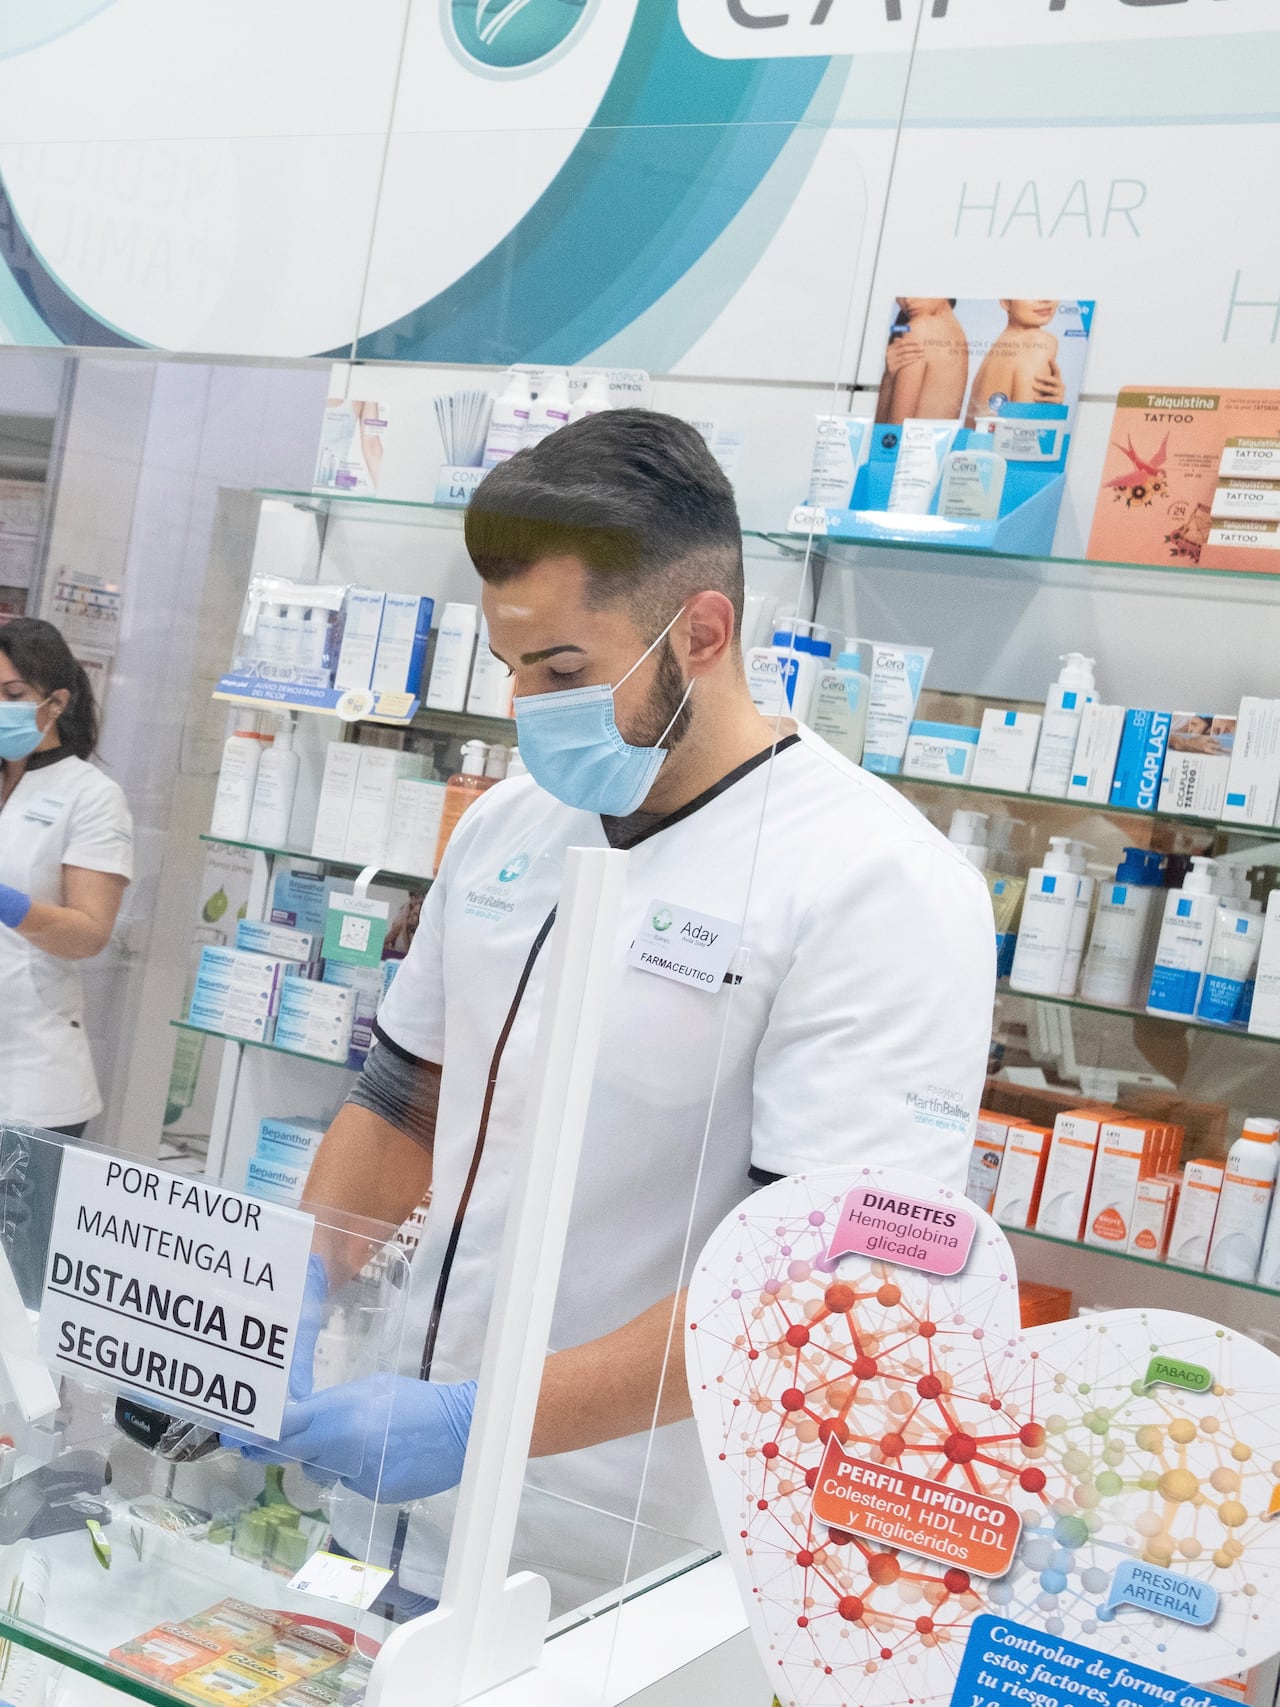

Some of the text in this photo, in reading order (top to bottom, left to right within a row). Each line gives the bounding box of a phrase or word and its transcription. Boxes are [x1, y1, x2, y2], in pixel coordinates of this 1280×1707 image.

[952, 177, 1147, 240] HAAR
[608, 383, 643, 392] ONTROL
[1147, 394, 1215, 410] Talquistina
[1144, 413, 1195, 424] TATTOO
[1234, 450, 1274, 459] TATTOO
[1225, 492, 1264, 501] TATTOO
[1220, 533, 1258, 543] TATTOO
[876, 656, 921, 672] CeraVe
[1136, 711, 1170, 809] CICAPLAST
[680, 921, 719, 946] Aday
[640, 952, 715, 984] FARMACEUTICO
[261, 1124, 312, 1148] Bepanthol
[249, 1162, 298, 1186] Bepanthol
[106, 1161, 262, 1231] POR FAVOR
[862, 1191, 958, 1229] DIABETES
[848, 1208, 960, 1250] Hemoglobina
[77, 1205, 275, 1291] MANTENGA LA
[866, 1232, 928, 1261] glicada
[51, 1252, 289, 1361] DISTANCIA DE
[58, 1320, 258, 1417] SEGURIDAD
[1155, 1362, 1205, 1385] TABACO
[836, 1460, 1006, 1528] PERFIL LIPÍDICO
[823, 1479, 1008, 1552] Colesterol, HDL, LDL
[847, 1510, 969, 1561] y Triglicéridos
[1131, 1566, 1203, 1601] PRESIÓN
[223, 1600, 283, 1626] Ricola
[1122, 1583, 1200, 1619] ARTERIAL
[161, 1624, 221, 1651] Ricola
[290, 1627, 349, 1653] Ricola
[226, 1653, 288, 1682] Ricola
[982, 1648, 1029, 1675] estos
[1025, 1662, 1111, 1707] factores,
[989, 1625, 1084, 1671] Controlar
[1093, 1660, 1112, 1680] de
[1111, 1667, 1177, 1703] forma
[976, 1669, 1059, 1707] tu riesgo
